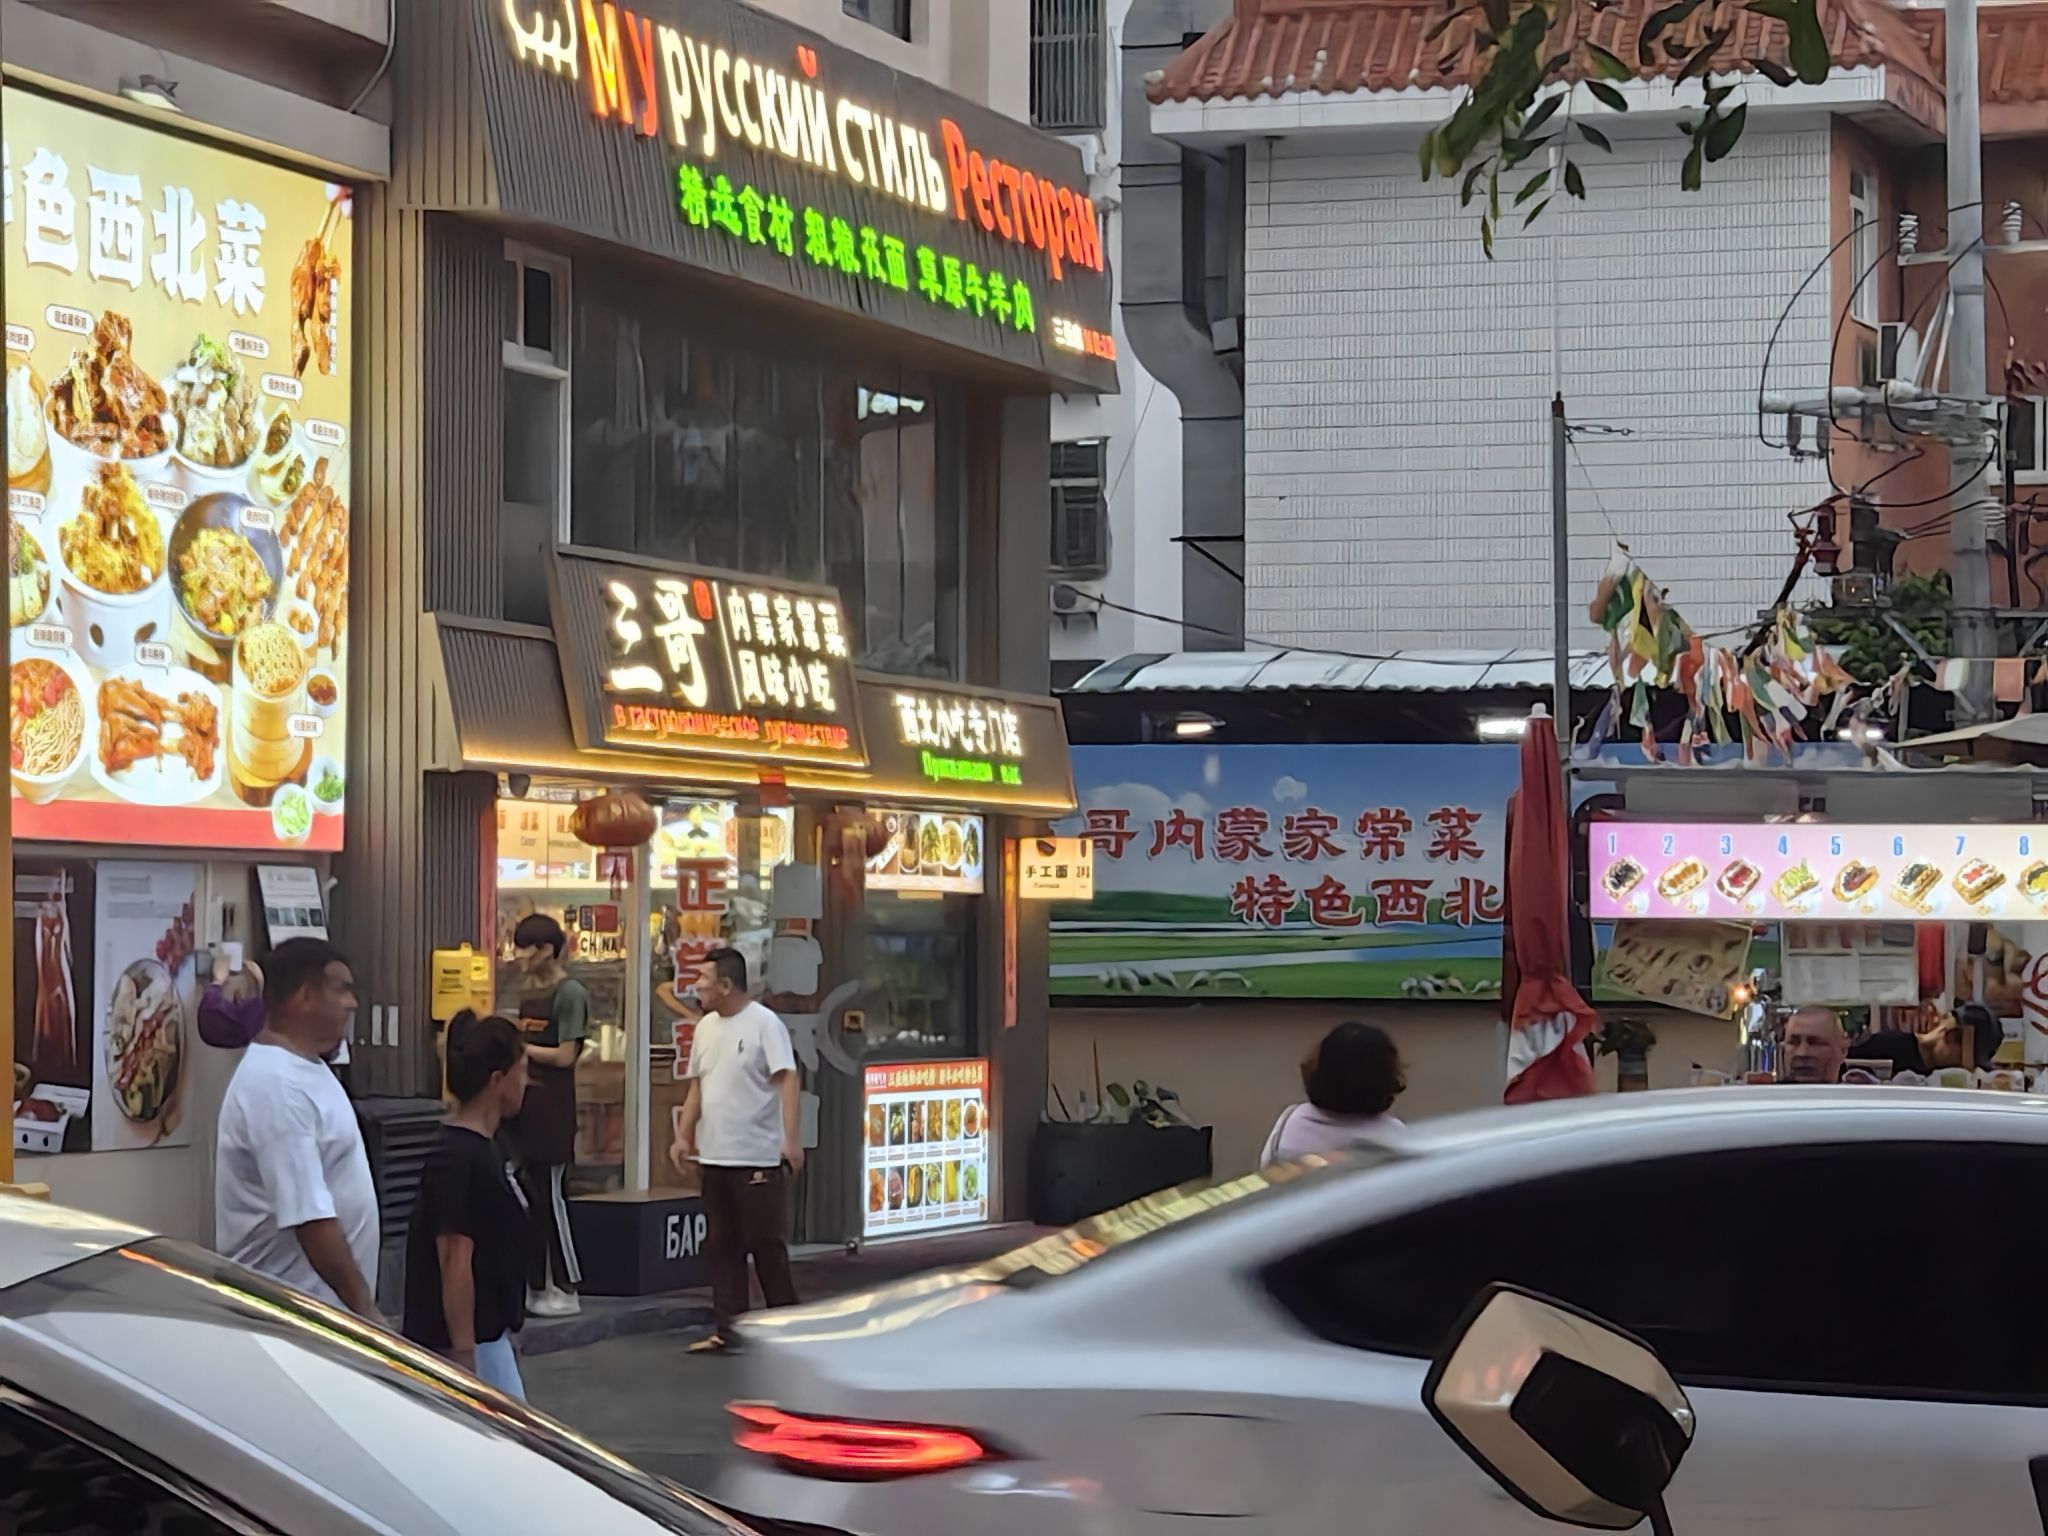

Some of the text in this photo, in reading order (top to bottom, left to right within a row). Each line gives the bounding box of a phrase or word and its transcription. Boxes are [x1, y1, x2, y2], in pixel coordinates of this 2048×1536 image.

[836, 98, 947, 213] стиль
[941, 117, 1104, 281] Ресторан
[4, 143, 267, 316] 色西北菜
[609, 579, 706, 707] 三哥
[728, 588, 847, 657] 内蒙家常菜
[738, 650, 836, 712] 风味小吃
[1663, 834, 1674, 856] 2
[1719, 835, 1732, 856] 3
[1777, 834, 1788, 856] 4
[1830, 835, 1842, 856] 5
[1892, 835, 1904, 857] 6
[1954, 835, 1966, 857] 7
[2018, 835, 2030, 857] 8
[1231, 873, 1505, 928] 特色西北
[665, 1213, 708, 1261] БАР
